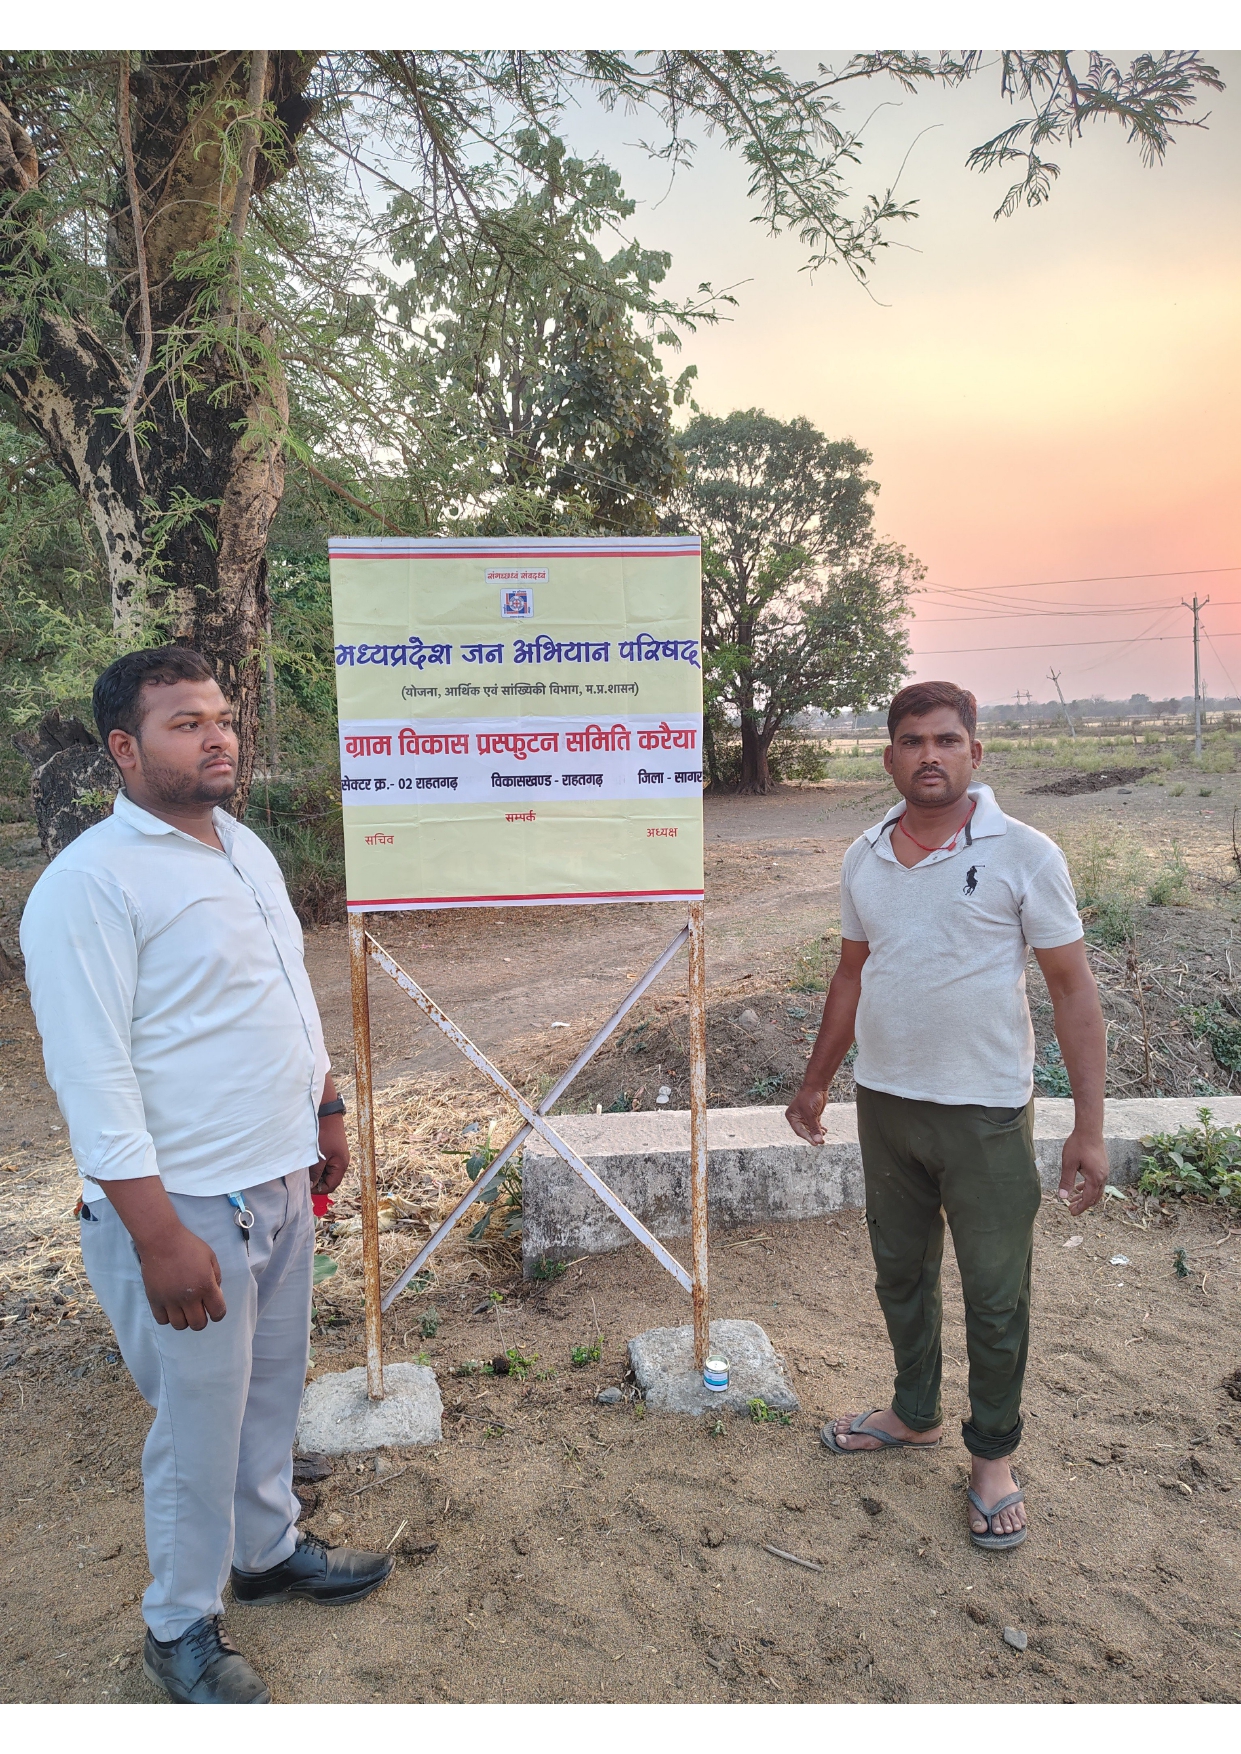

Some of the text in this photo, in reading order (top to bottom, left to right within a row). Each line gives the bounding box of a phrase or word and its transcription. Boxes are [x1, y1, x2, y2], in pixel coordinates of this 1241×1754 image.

[335, 633, 701, 670] मध्यप्रदेश जन अभियान परिषद्
[401, 682, 639, 700] (योजना, आर्थिक एवं सांख्यिकी विभाग, म.प्र.शासन)
[344, 721, 697, 760] ग्राम विकास प्रस्फुटन समिति करैया
[341, 775, 371, 791] सेक्टर
[398, 778, 412, 790] 02
[415, 776, 458, 791] राहतगढ़
[491, 772, 552, 787] विकासखण्ड
[562, 774, 603, 787] राहतगढ़
[638, 768, 664, 784] जिला
[505, 810, 536, 822] सम्पर्क
[364, 833, 394, 845] सचिव
[646, 827, 678, 838] अध्यक्ष
